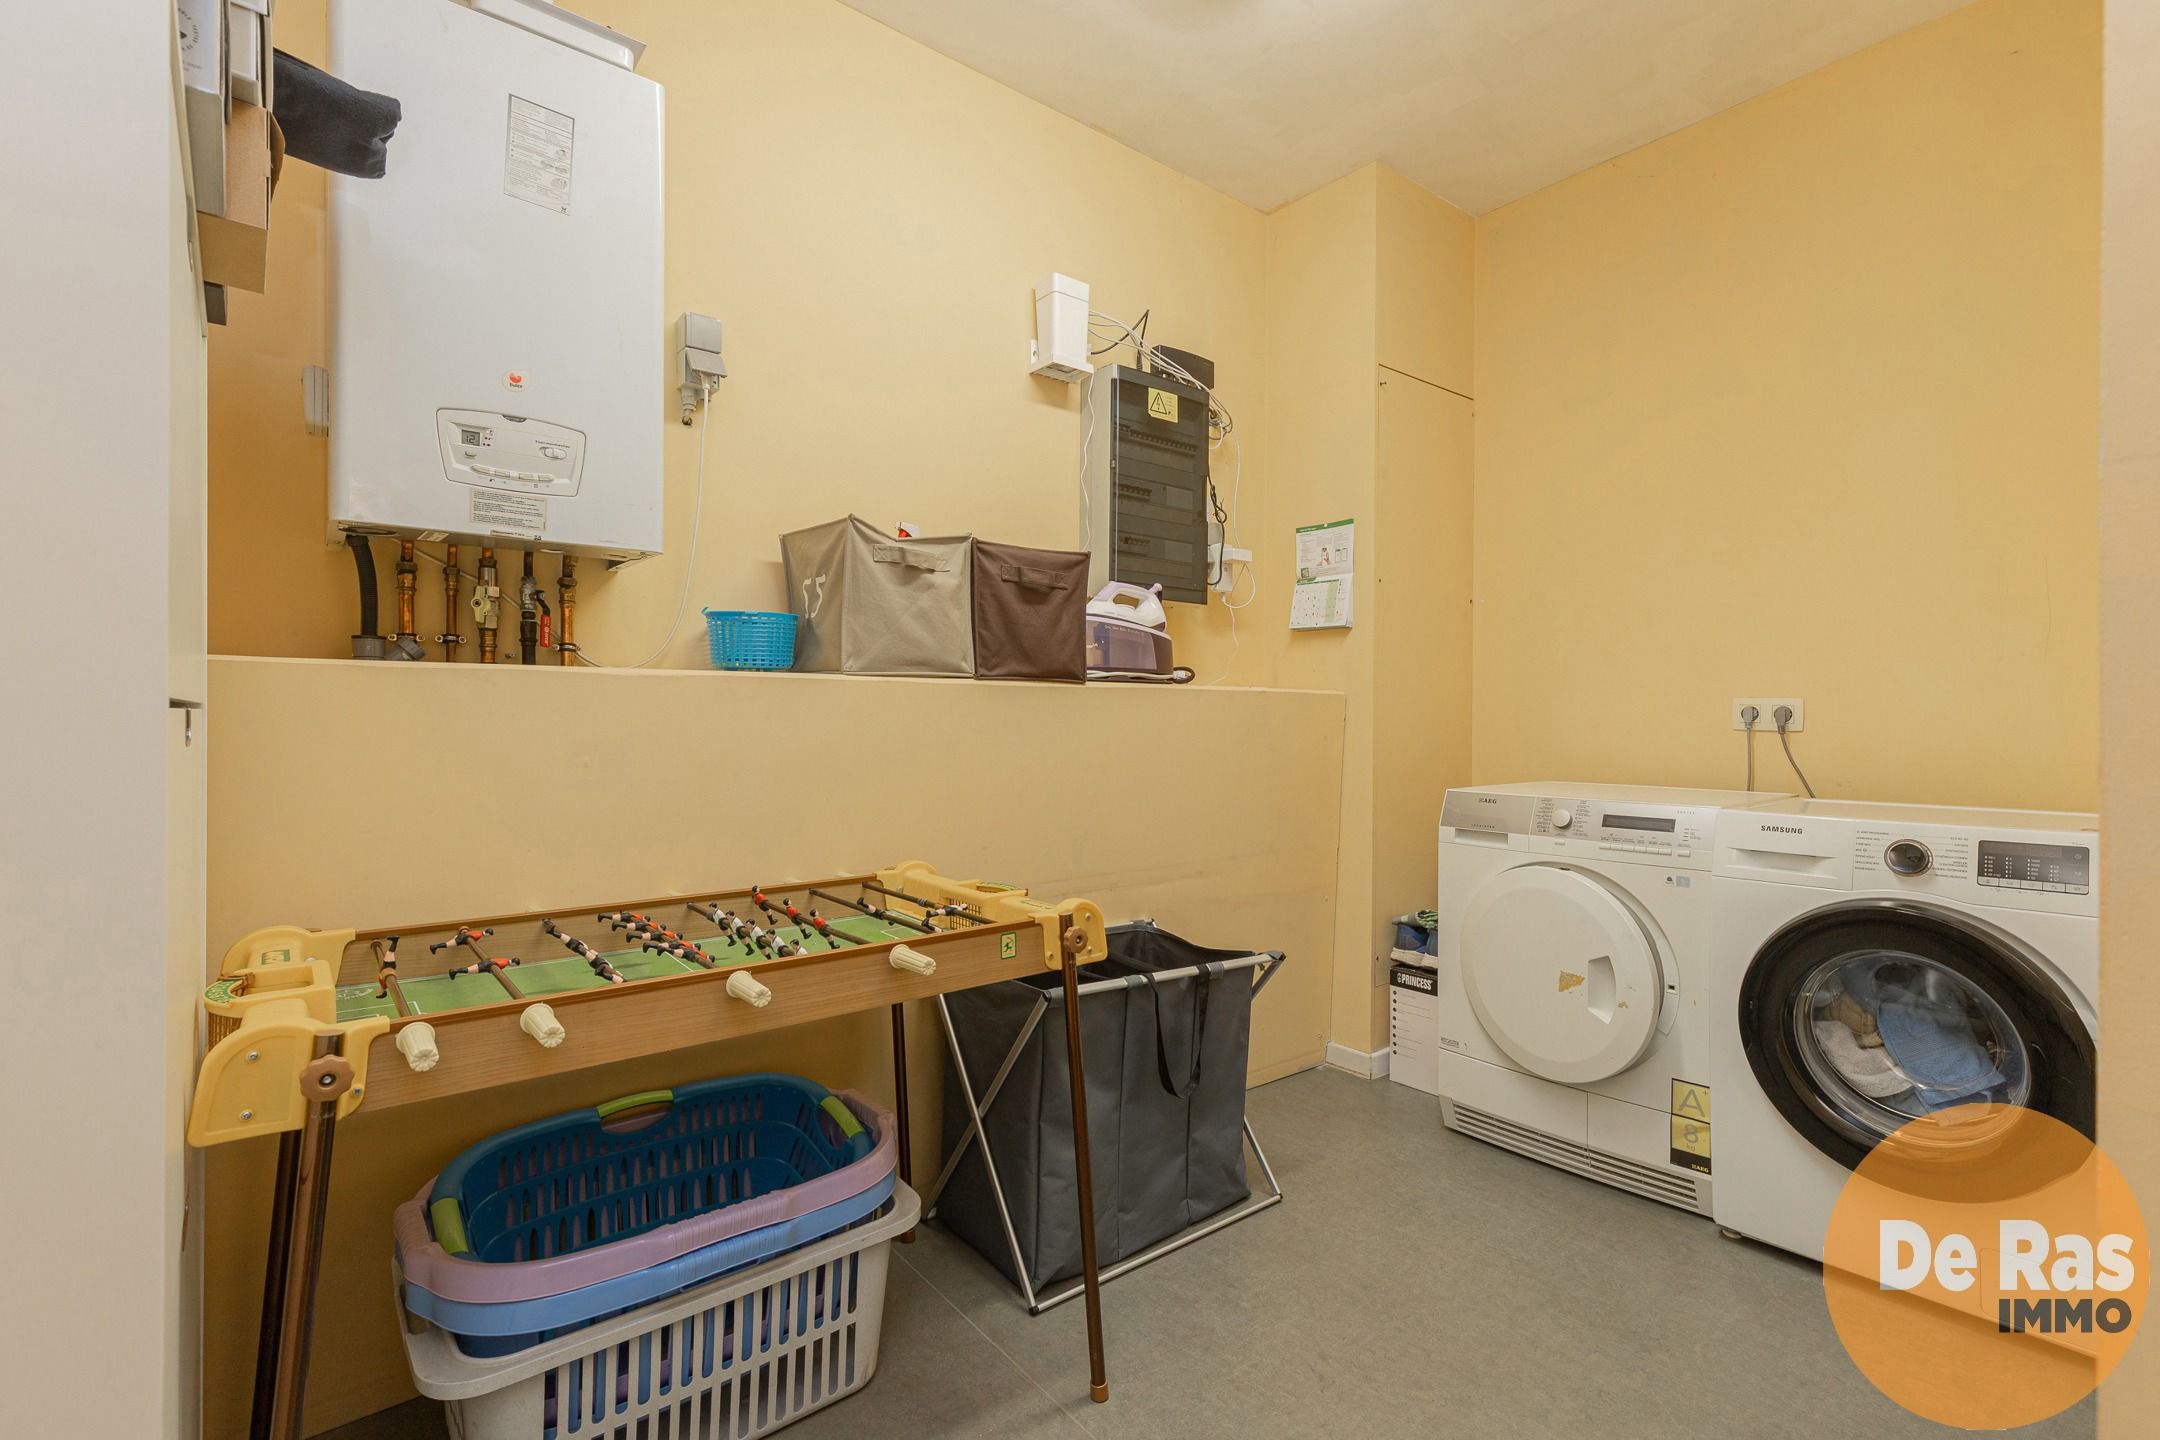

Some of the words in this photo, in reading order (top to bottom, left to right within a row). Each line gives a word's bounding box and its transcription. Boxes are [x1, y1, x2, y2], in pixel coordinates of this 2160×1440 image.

[1760, 825, 1803, 835] SAMSUNG
[1401, 973, 1432, 991] PRINCESS
[1684, 1124, 1699, 1144] 8
